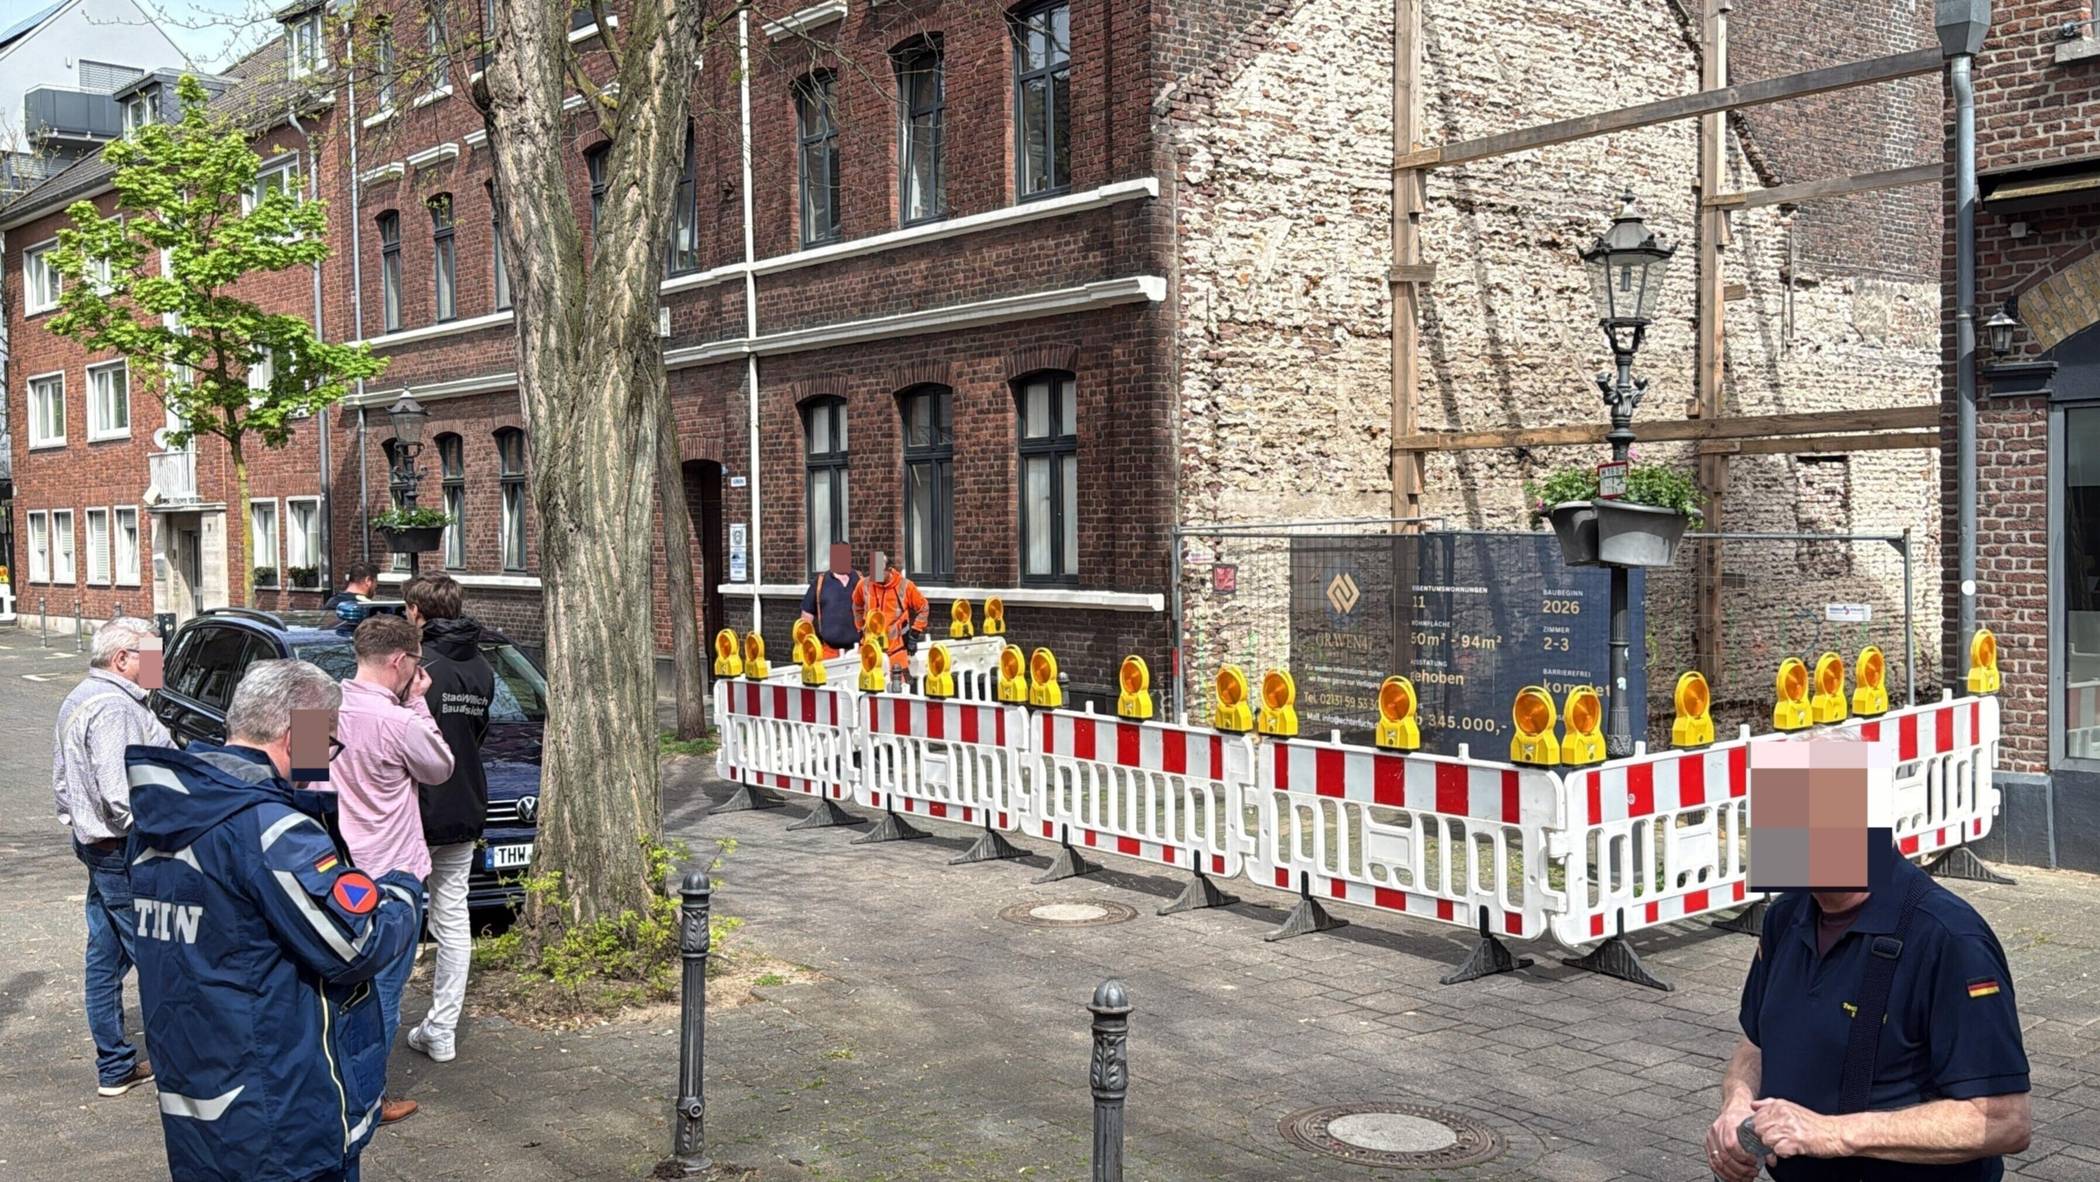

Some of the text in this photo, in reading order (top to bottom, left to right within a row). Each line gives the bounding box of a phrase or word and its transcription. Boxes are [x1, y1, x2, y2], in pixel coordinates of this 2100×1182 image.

[1542, 589, 1584, 597] BAUBEGINN
[1412, 595, 1426, 608] 11
[1542, 599, 1580, 615] 2026
[1542, 625, 1571, 633] ZIMMER
[1543, 636, 1570, 652] 2-3
[1542, 668, 1592, 677] BARRIEREFREI
[1344, 695, 1356, 708] 59
[1357, 697, 1369, 709] 53
[1428, 714, 1508, 735] 345.000,-
[498, 846, 526, 865] THW
[133, 898, 204, 945] THW
